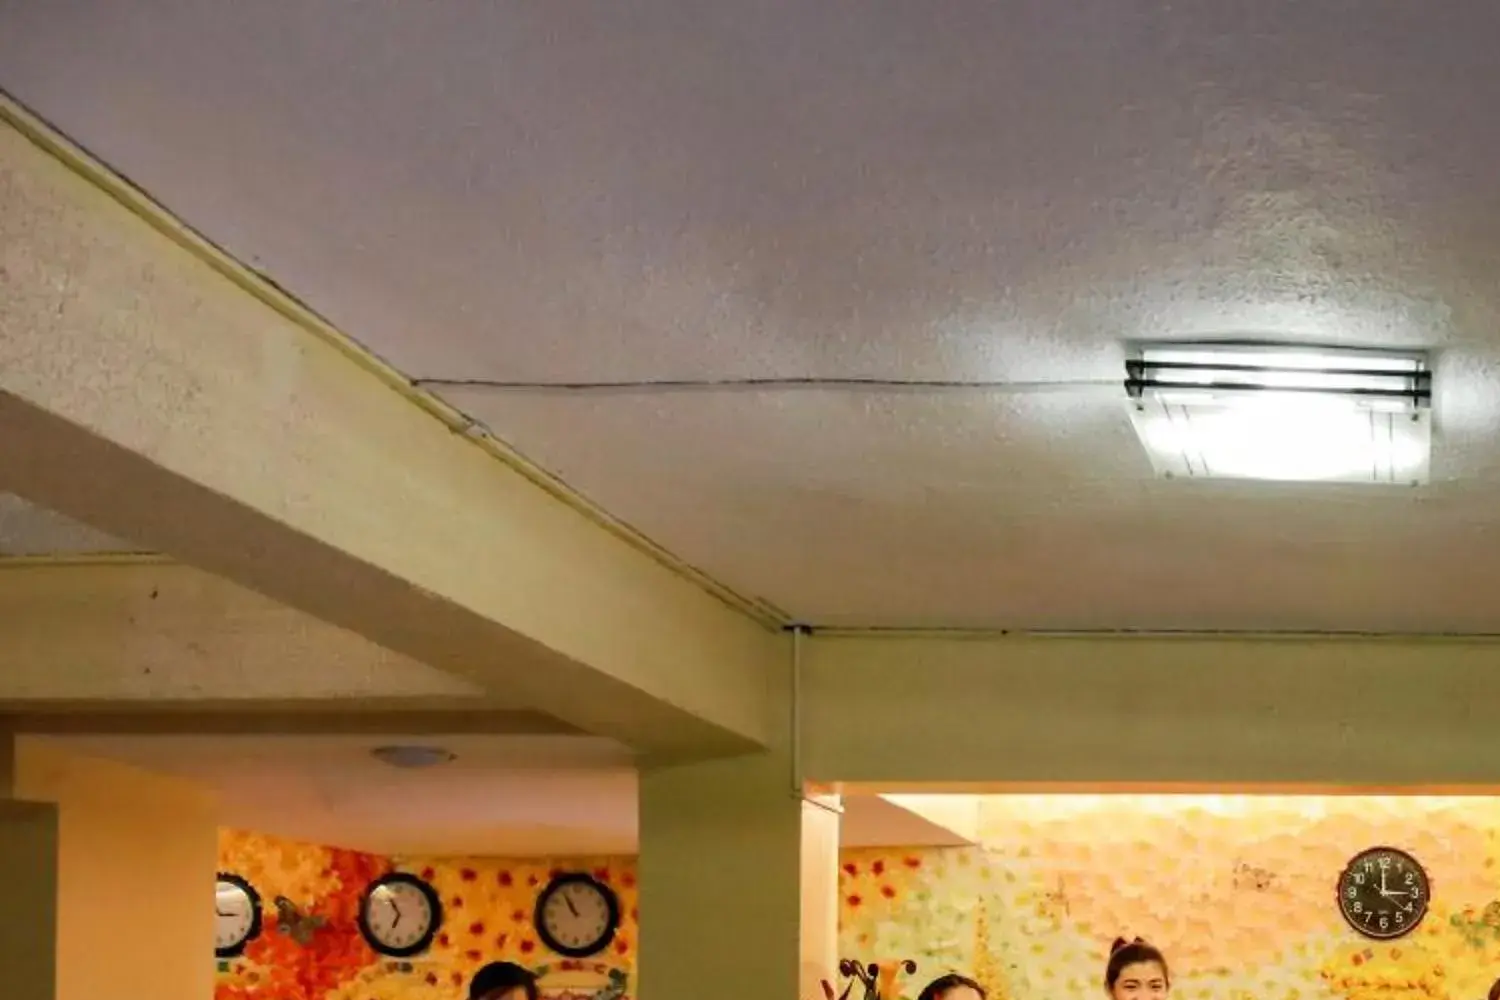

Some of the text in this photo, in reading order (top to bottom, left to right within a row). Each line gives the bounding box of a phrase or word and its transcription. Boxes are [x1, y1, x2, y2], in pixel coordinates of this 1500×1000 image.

[1364, 863, 1373, 873] 11
[1404, 872, 1413, 885] 2
[1353, 902, 1362, 913] 8
[1364, 912, 1373, 923] 7
[1395, 912, 1403, 923] 5
[1380, 918, 1388, 929] 6
